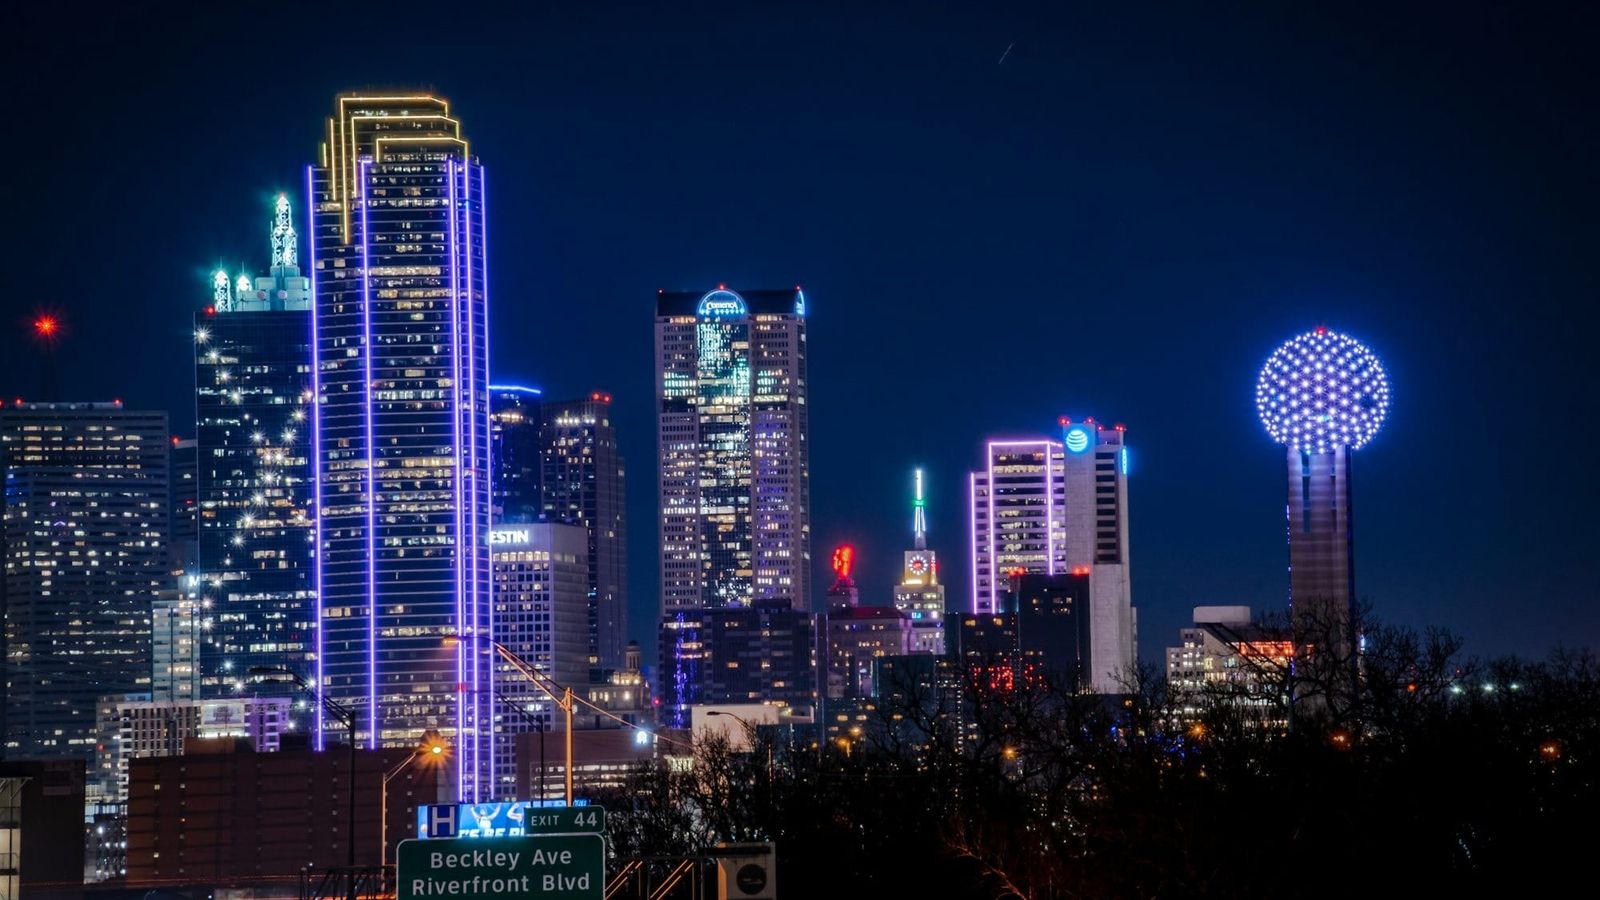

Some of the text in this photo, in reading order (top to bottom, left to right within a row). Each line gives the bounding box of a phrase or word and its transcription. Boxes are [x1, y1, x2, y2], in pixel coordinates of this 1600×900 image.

[432, 806, 455, 836] H
[531, 812, 597, 827] EXIT 44
[431, 849, 572, 871] Beckley Ave
[412, 872, 590, 896] Riverfront Blvd
